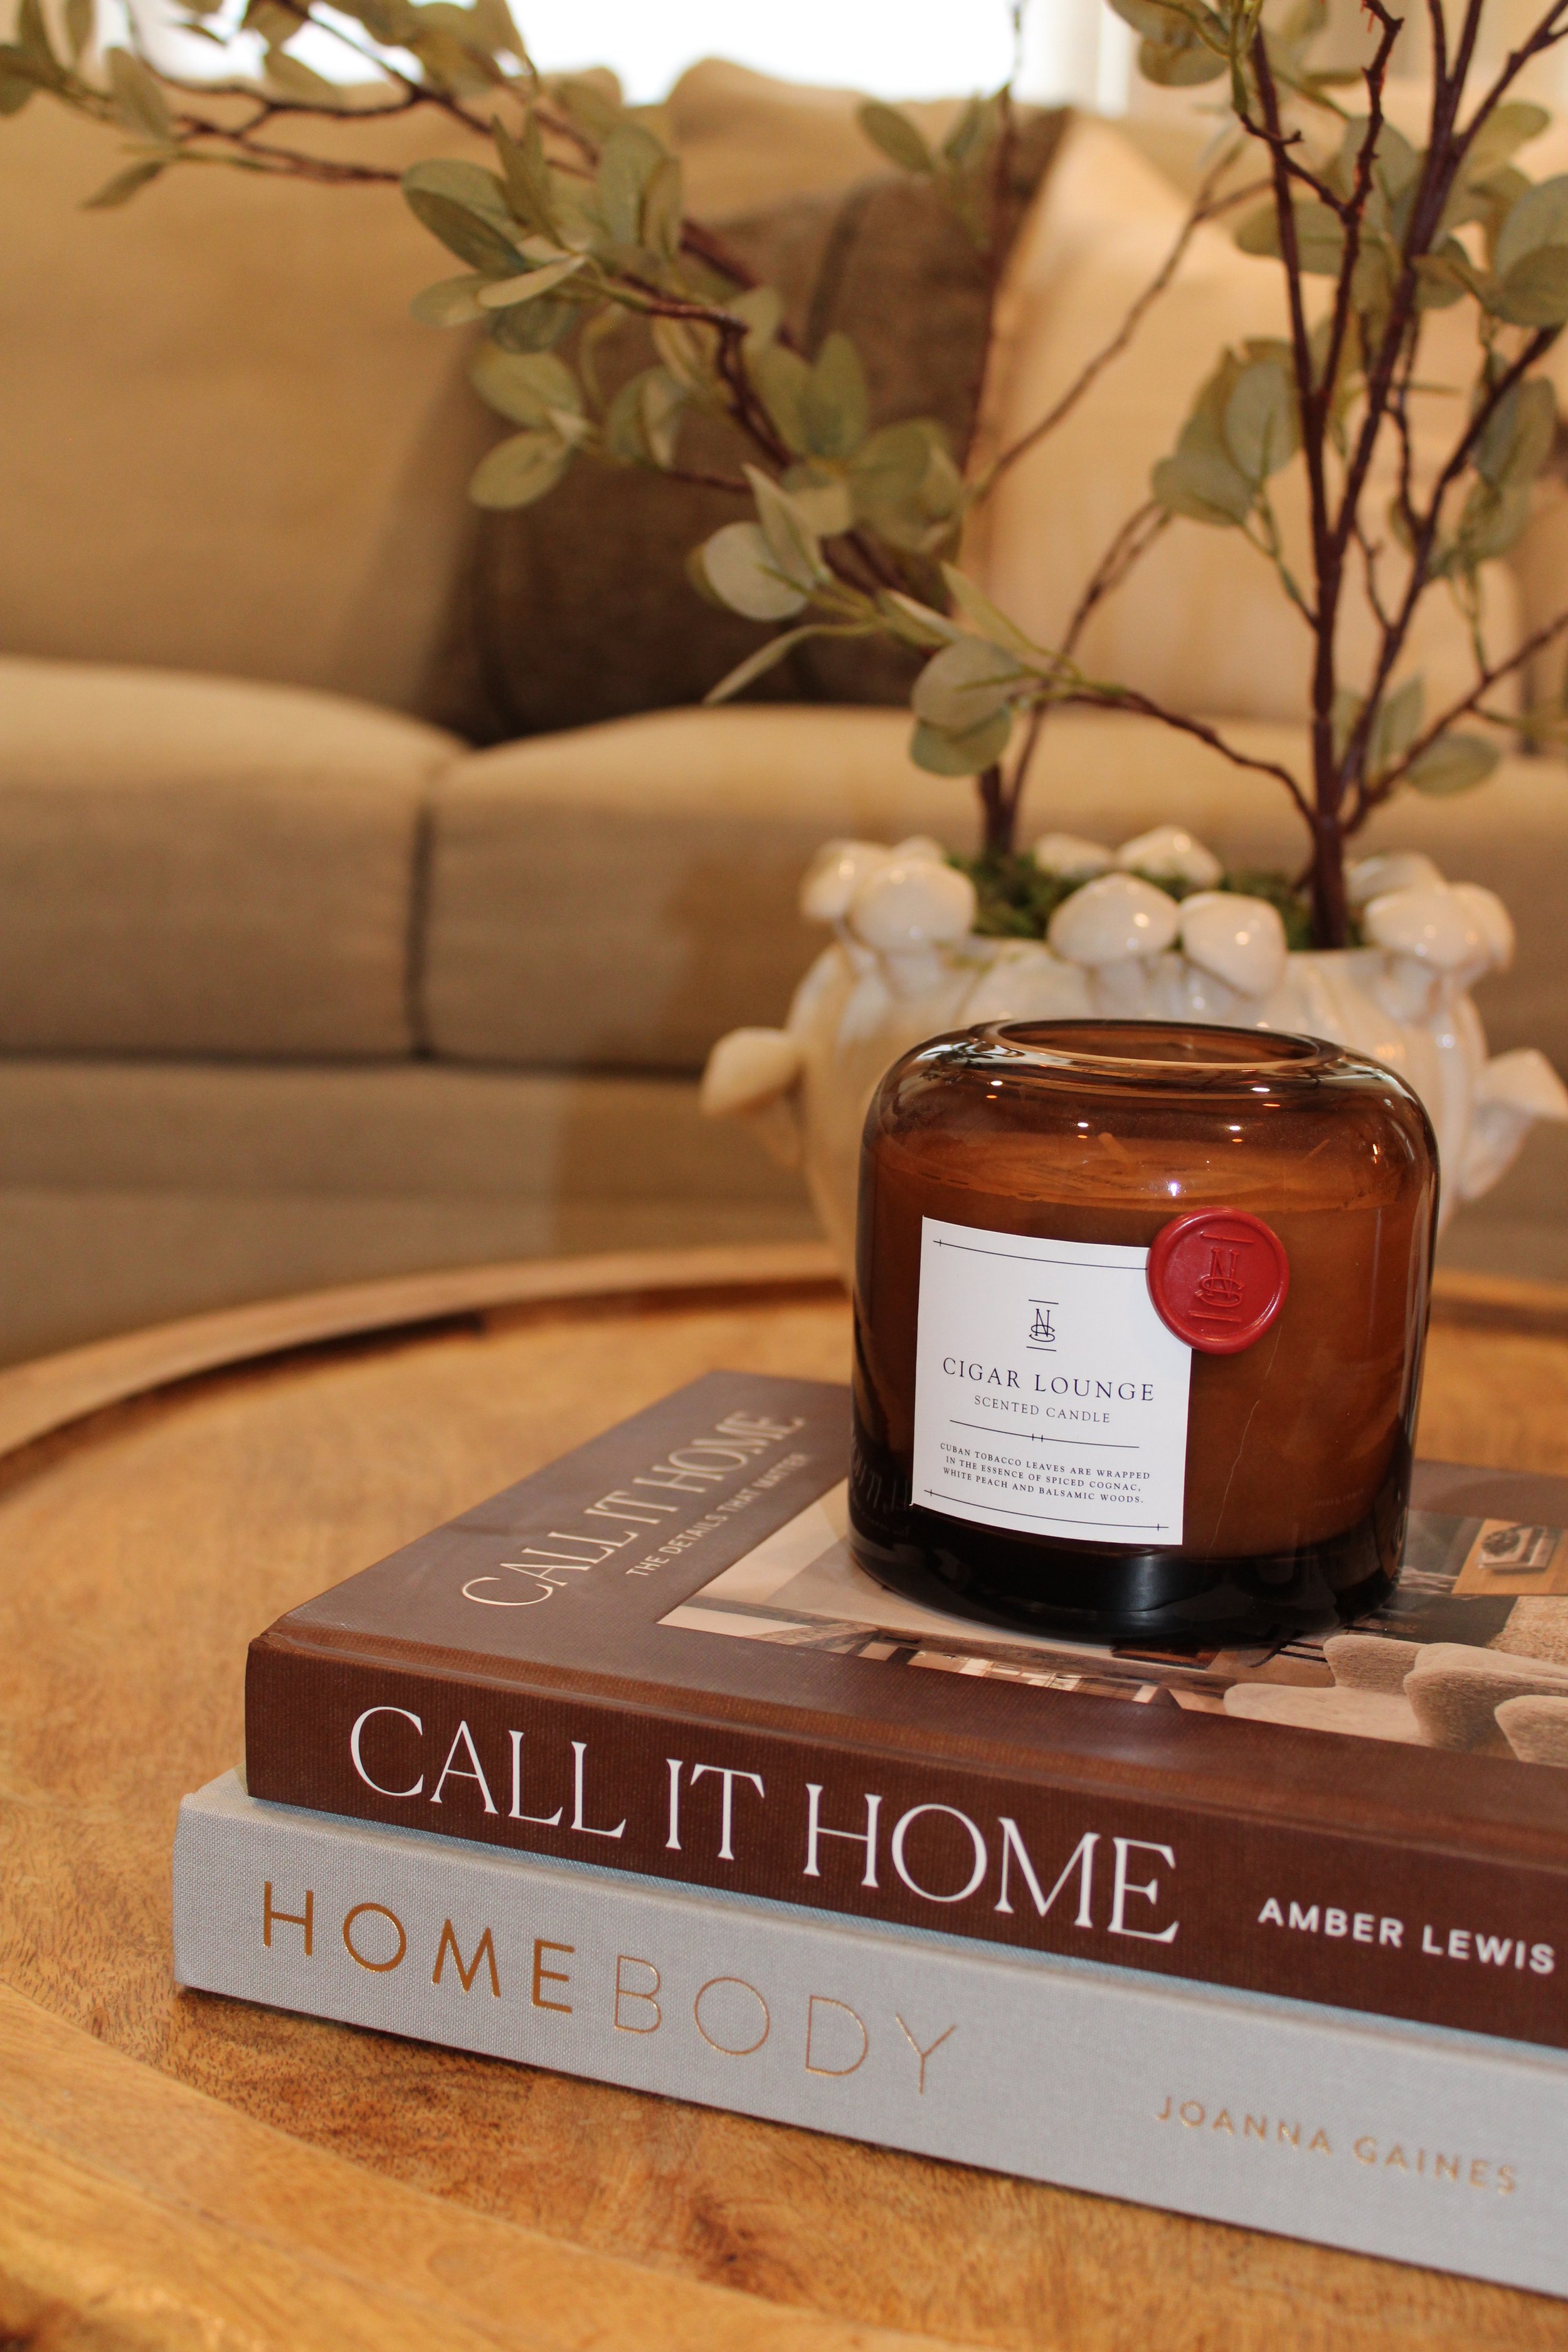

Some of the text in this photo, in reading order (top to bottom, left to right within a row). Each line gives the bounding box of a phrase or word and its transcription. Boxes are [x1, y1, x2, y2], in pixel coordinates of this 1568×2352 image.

[943, 1357, 1154, 1401] CIGAR LOUNGE
[974, 1395, 1110, 1423] SCENTED CANDLE
[940, 1443, 1150, 1480] CUBAN TOBACCO LEAVES ARE WRAPPED
[943, 1467, 1144, 1503] WHITE PEACH AND BALSAMIC WOODS.
[946, 1456, 1141, 1491] IN THE ESSENCE OF SPICED COGNAC,
[462, 1411, 805, 1606] CALL IT HOME
[625, 1555, 670, 1576] THE
[659, 1514, 729, 1555] DETAILS
[716, 1488, 763, 1513] THAT
[349, 1706, 1180, 1943] CALL IT HOME
[1258, 1897, 1555, 1974] AMBER LEWIS
[263, 1881, 956, 2095] HOMEBODY
[1155, 2095, 1517, 2196] JOANNA GAINES
